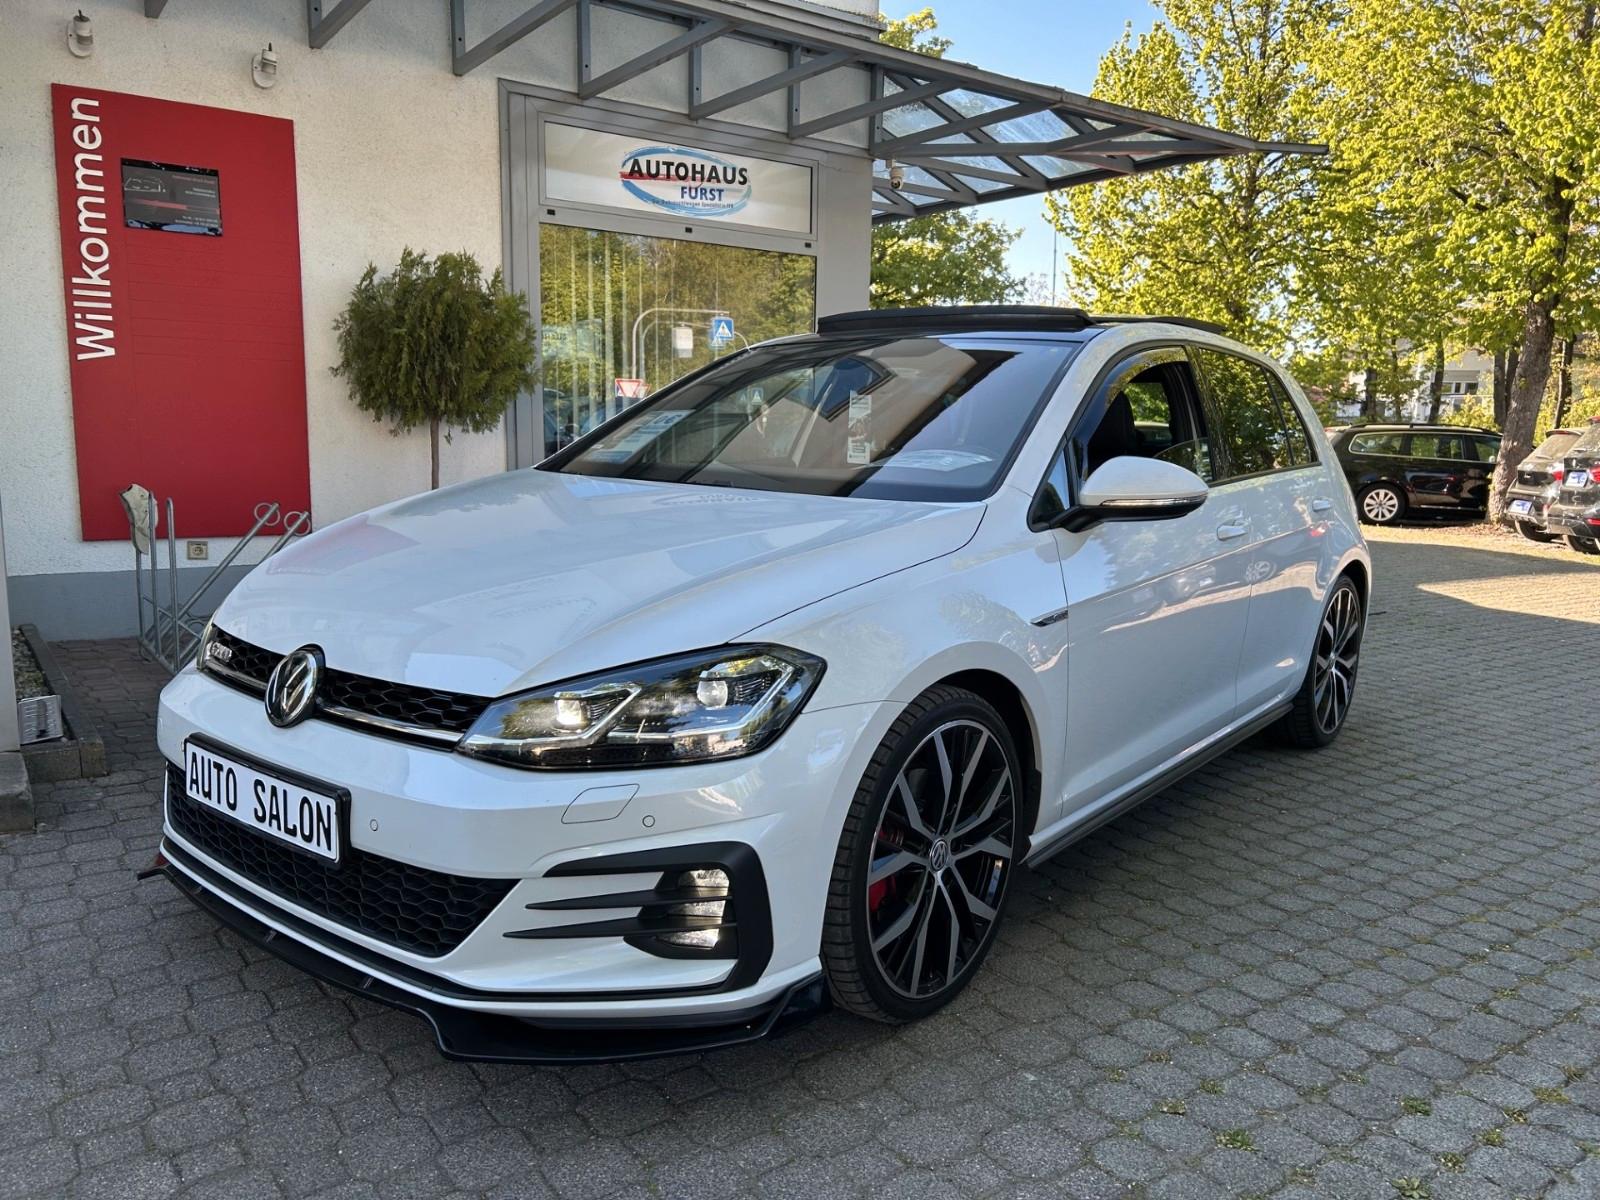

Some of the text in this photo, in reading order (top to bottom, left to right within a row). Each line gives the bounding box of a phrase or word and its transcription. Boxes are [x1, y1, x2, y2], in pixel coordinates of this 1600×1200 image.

[628, 158, 748, 185] AUTOHAUS
[70, 97, 115, 360] Willkommen
[189, 751, 332, 852] AUTO SALON
